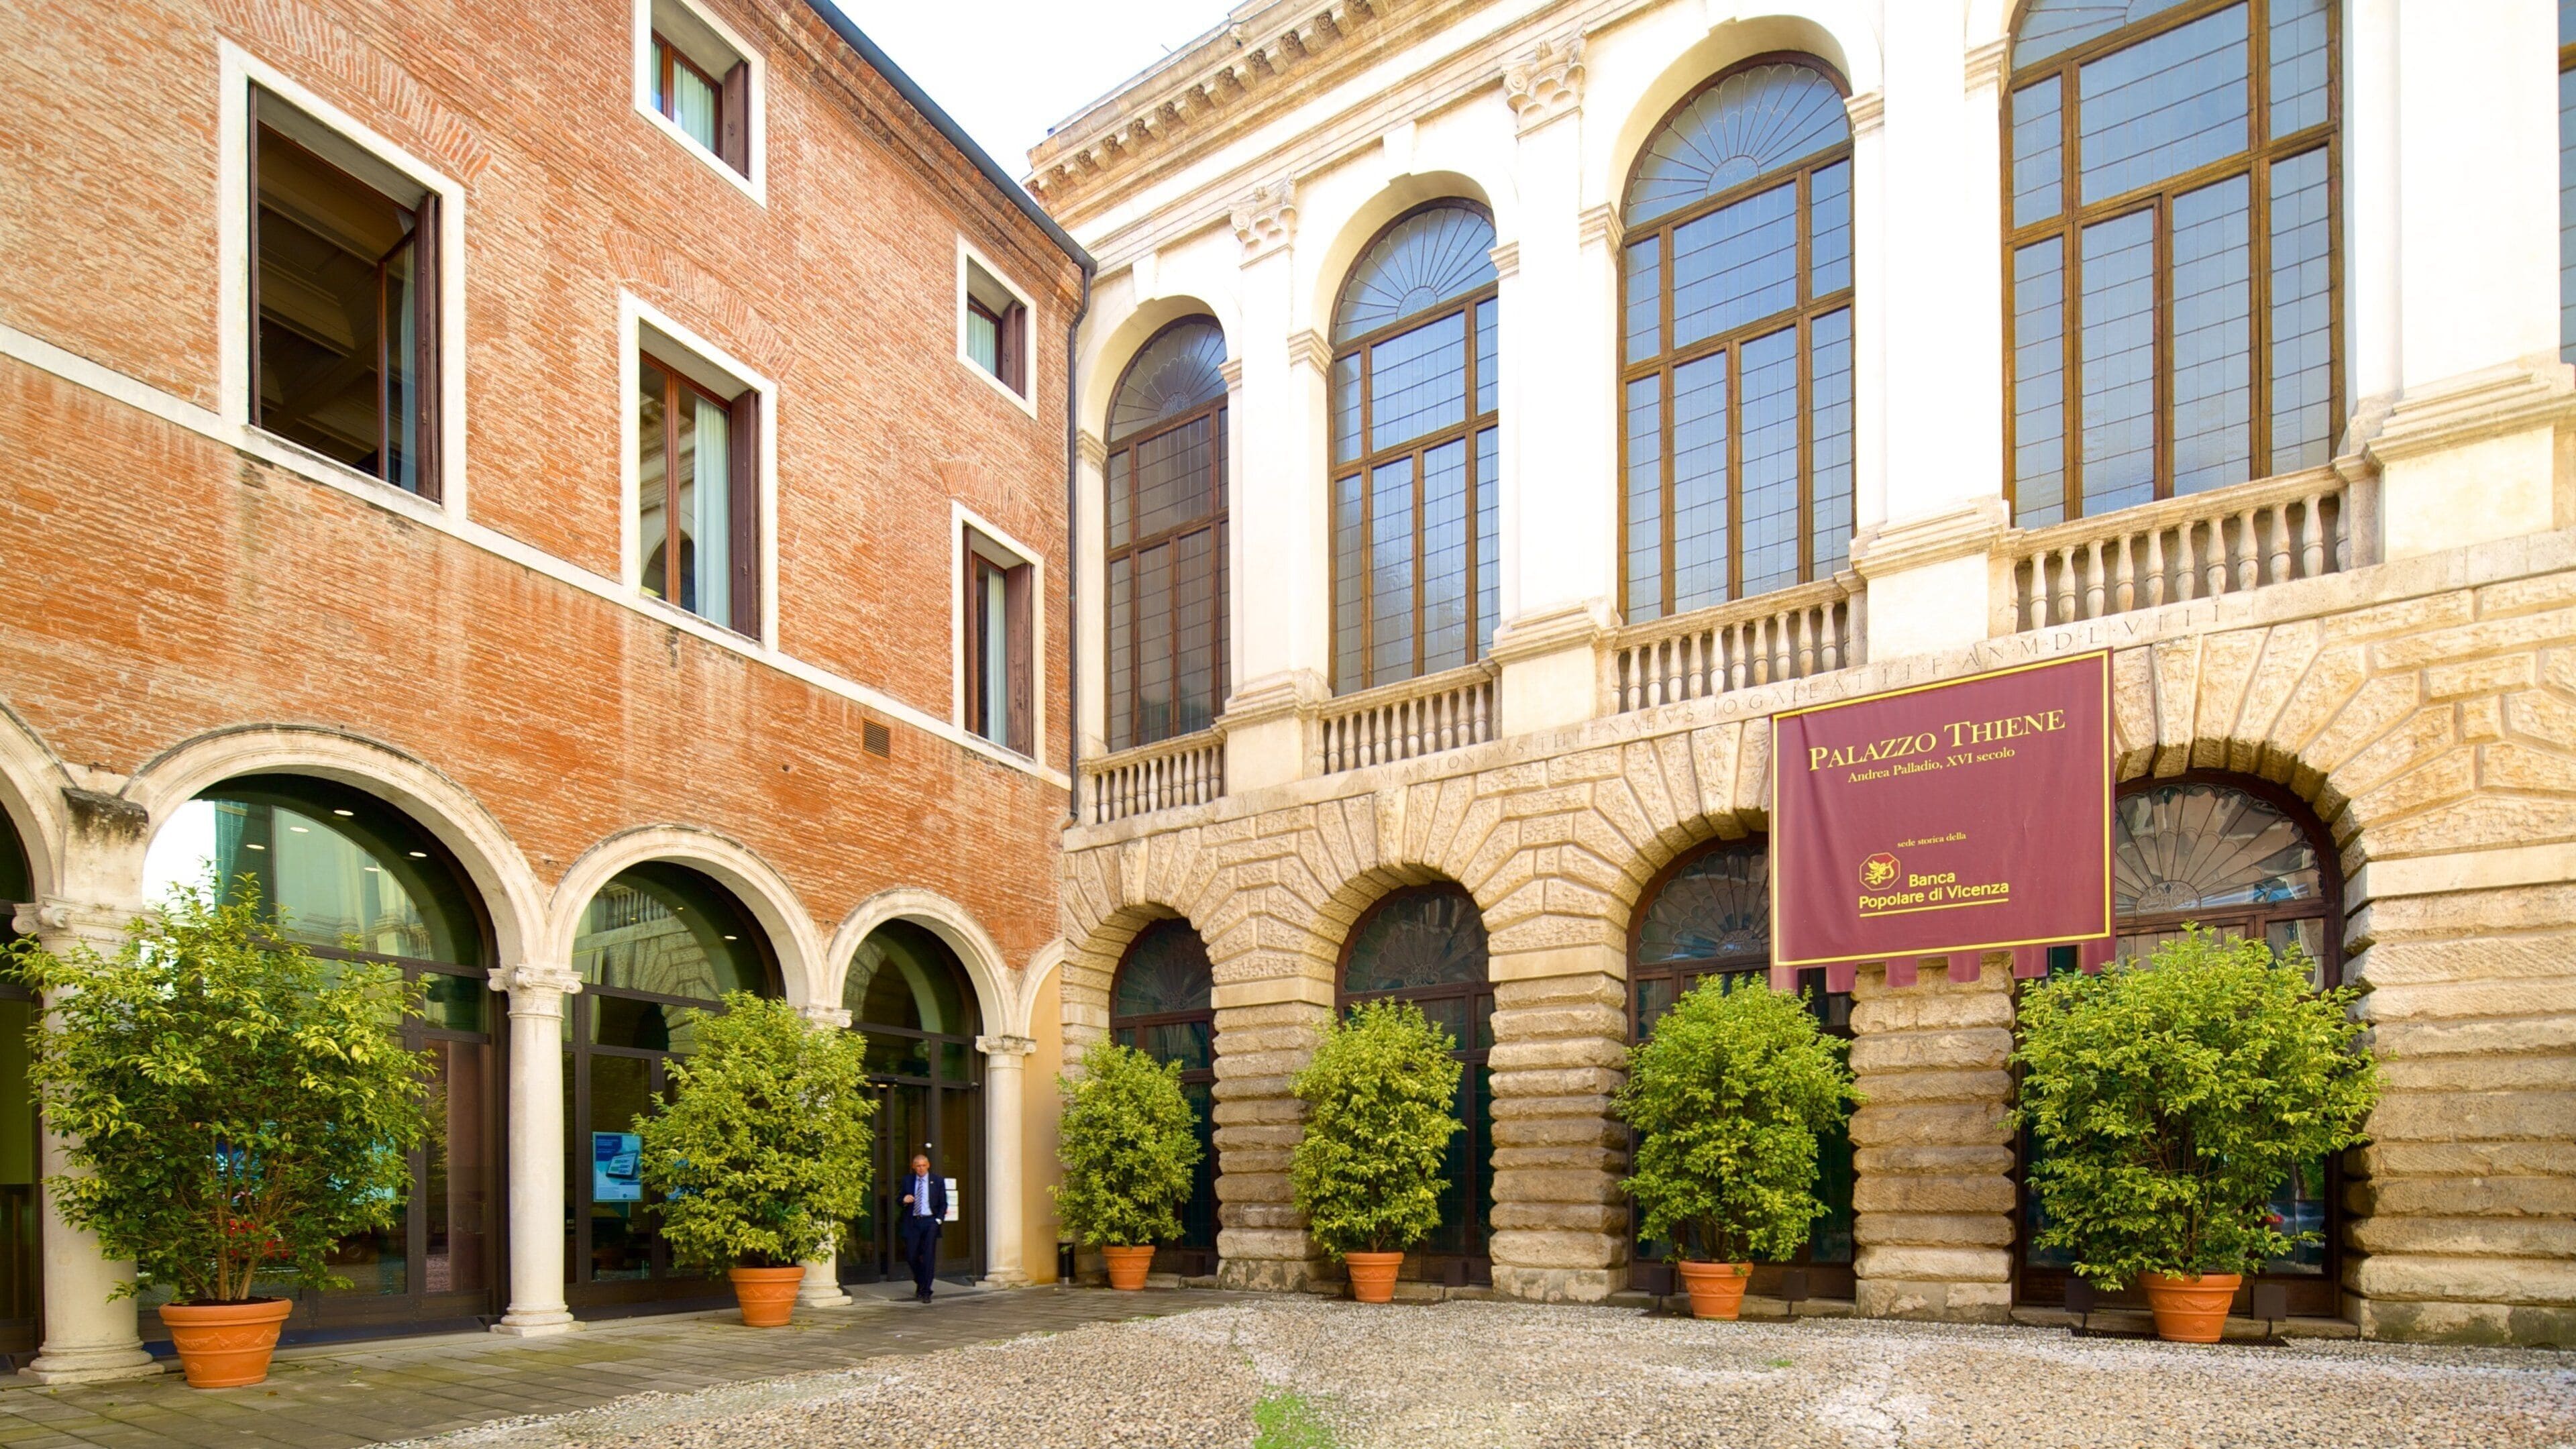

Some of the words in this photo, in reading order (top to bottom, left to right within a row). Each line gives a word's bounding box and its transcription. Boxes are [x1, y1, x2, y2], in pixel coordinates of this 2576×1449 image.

[1809, 733, 1937, 771] PALAZZO
[1943, 709, 2065, 748] THIENE
[1847, 769, 1890, 783] Andrea
[1893, 759, 1943, 776] Palladio,
[1946, 753, 1973, 767] XVI
[1976, 747, 2015, 762] secolo
[1897, 839, 1916, 848] sede
[1917, 836, 1944, 845] storica
[1945, 832, 1966, 841] della
[1909, 872, 1955, 888] Banca
[1859, 892, 1924, 910] Popolare
[1929, 888, 1942, 901] di
[1946, 883, 2009, 899] Vicenza
